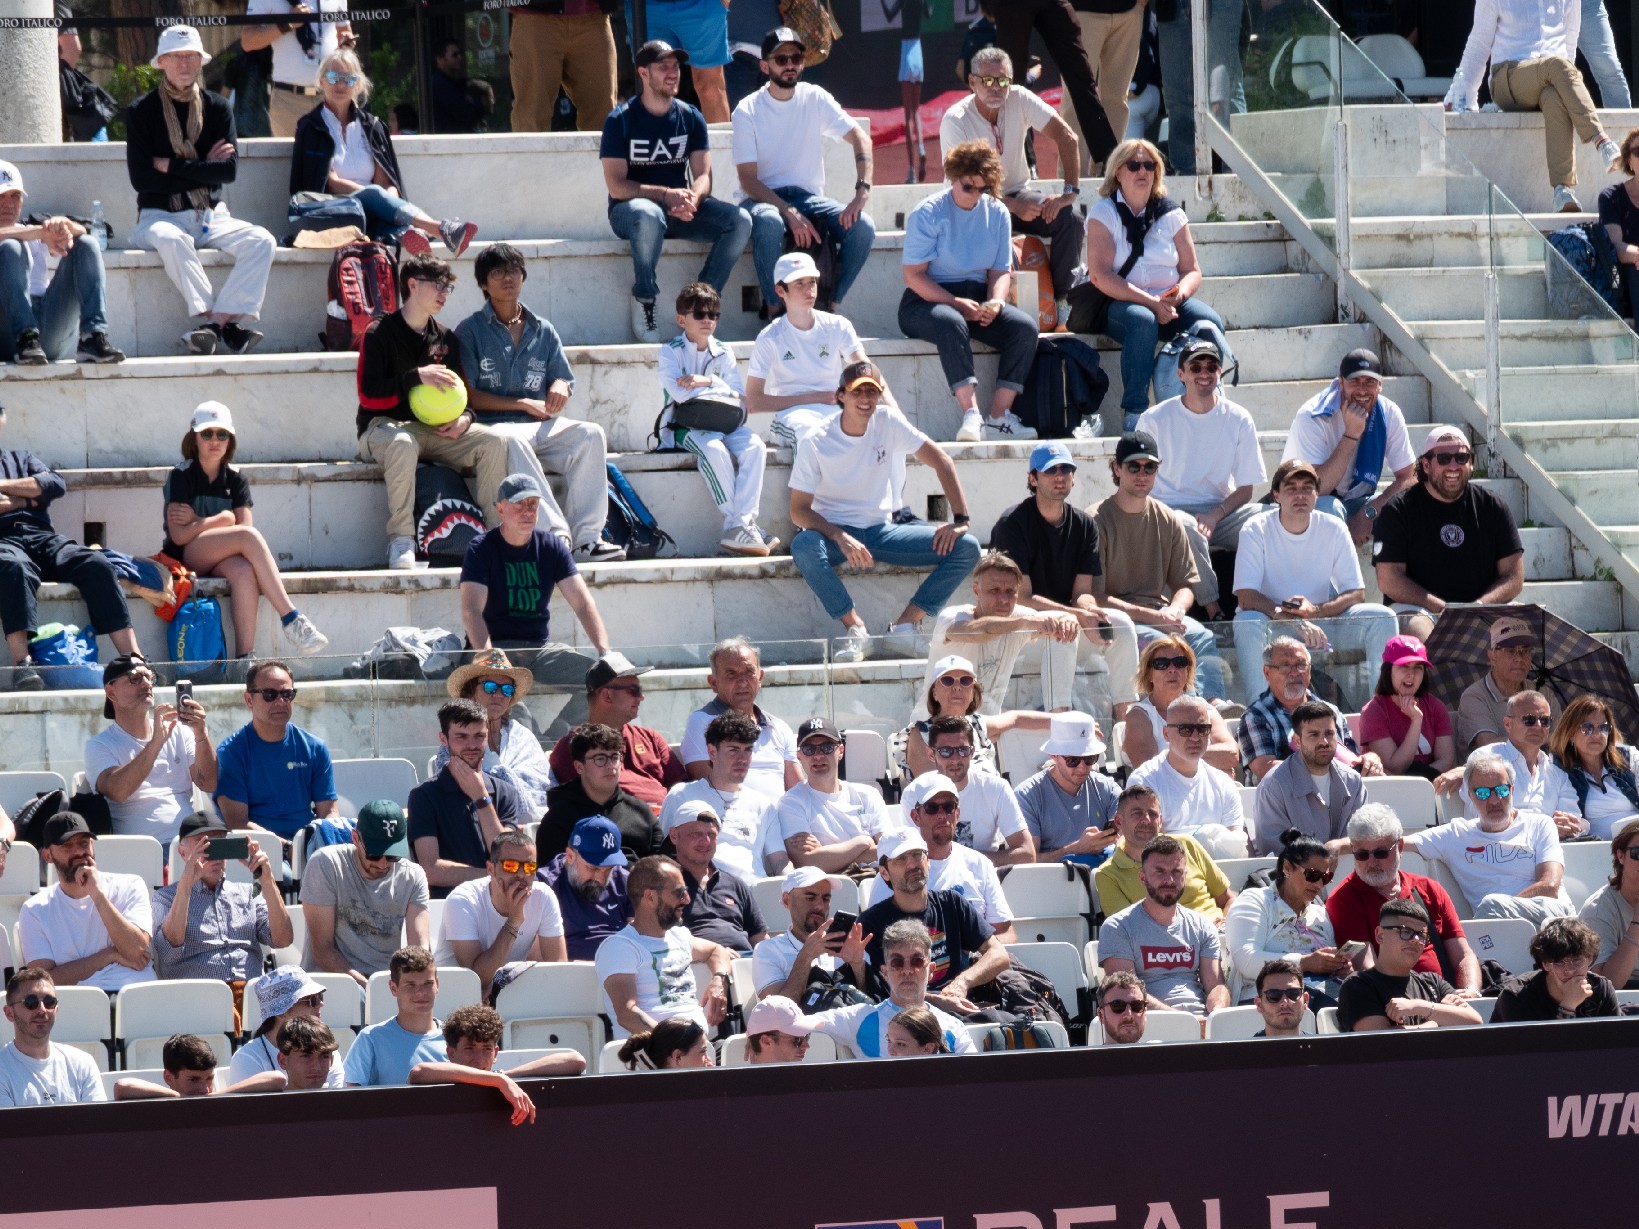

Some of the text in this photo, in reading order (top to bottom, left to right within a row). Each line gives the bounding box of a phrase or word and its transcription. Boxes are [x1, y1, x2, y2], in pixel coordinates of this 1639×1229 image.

[22, 18, 63, 28] ITALICO
[155, 16, 227, 27] FORO ITALICO
[320, 9, 391, 22] FORO ITALICO
[630, 134, 688, 161] EA7
[504, 561, 540, 588] DUN
[382, 819, 398, 838] RF
[602, 832, 615, 849] NY
[1464, 842, 1534, 864] FILA
[1547, 1092, 1639, 1139] WTA
